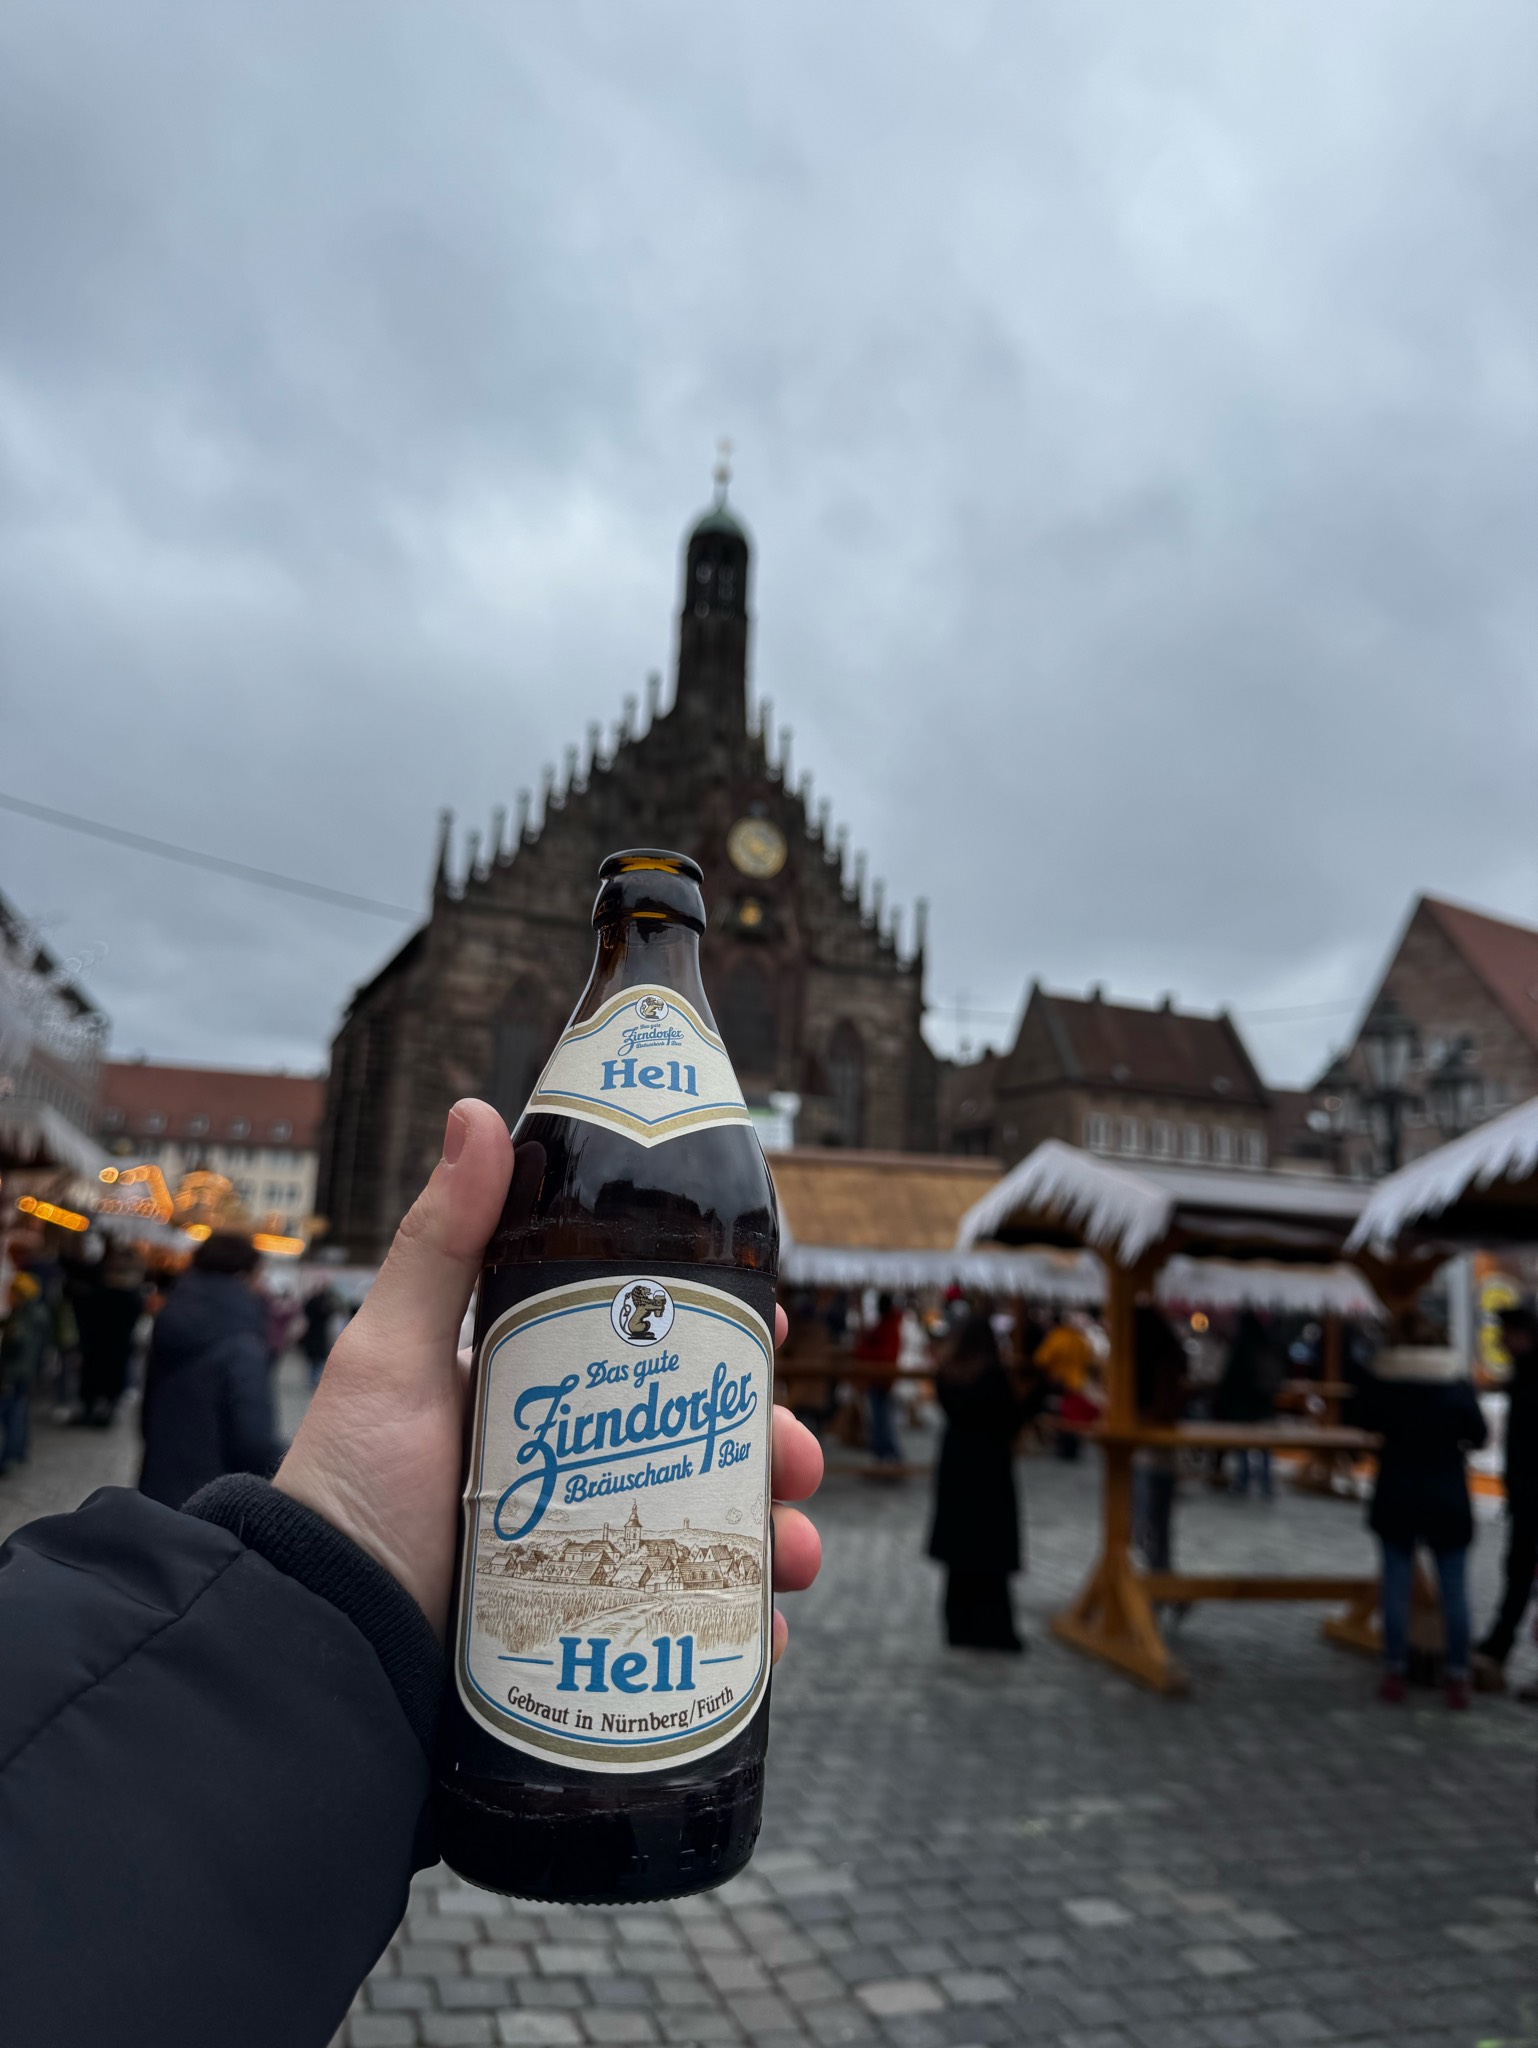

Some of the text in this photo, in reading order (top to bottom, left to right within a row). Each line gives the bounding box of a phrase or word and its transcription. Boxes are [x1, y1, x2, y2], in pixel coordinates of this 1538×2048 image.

[617, 1027, 684, 1056] Zirndorfer
[600, 1058, 699, 1096] Hell
[585, 1350, 680, 1389] Das gute
[493, 1361, 758, 1541] Zirndorfer
[564, 1440, 752, 1504] Bräuschank Bier
[556, 1634, 697, 1694] Hell
[507, 1685, 735, 1733] Gebraut in Nürnberg/Fürth
